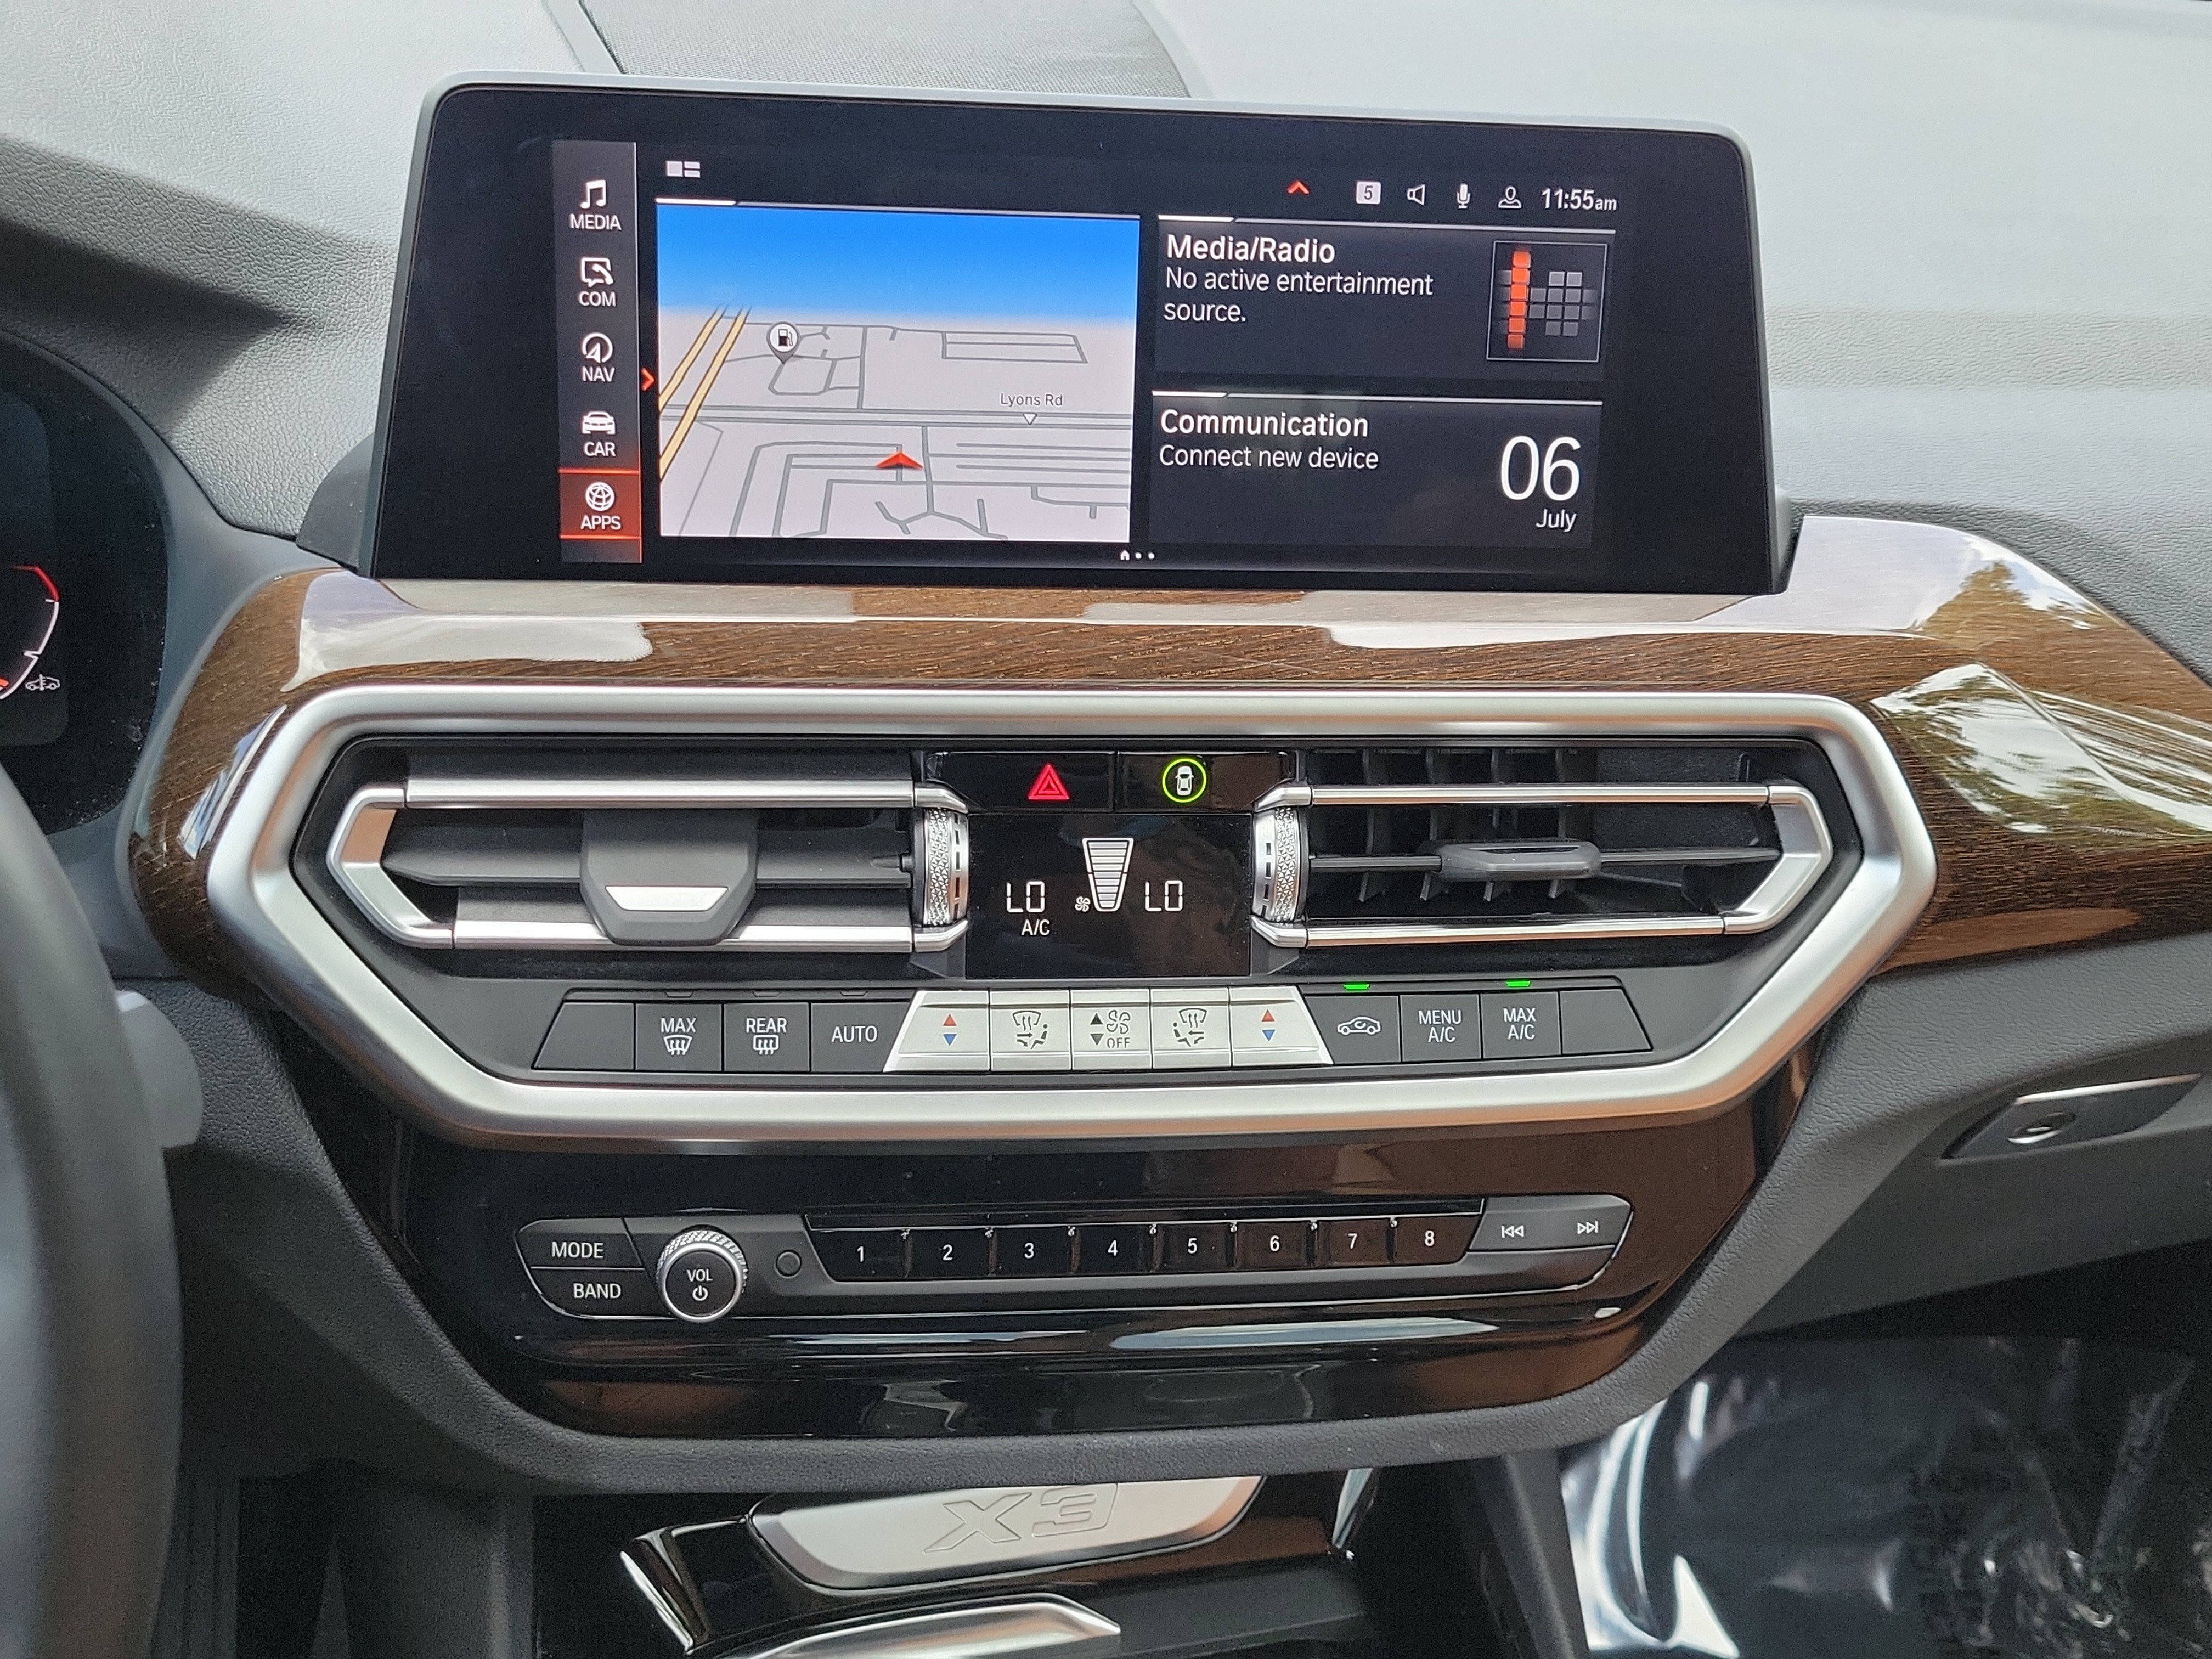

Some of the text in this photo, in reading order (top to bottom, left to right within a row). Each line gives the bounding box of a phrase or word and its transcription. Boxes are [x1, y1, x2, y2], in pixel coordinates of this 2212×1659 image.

[1364, 185, 1373, 200] 5
[1542, 188, 1617, 211] 11:55am
[569, 213, 622, 230] MEDIA
[1167, 234, 1335, 263] Media/Radio
[1166, 266, 1434, 296] No active entertainment
[578, 291, 616, 307] COM
[1164, 303, 1246, 322] source.
[582, 366, 615, 382] NAV
[1001, 393, 1063, 408] Lyons Rd
[1161, 409, 1368, 437] Communication
[584, 441, 616, 456] CAR
[1160, 444, 1379, 469] Connect new device
[1500, 435, 1581, 501] 06
[580, 515, 621, 530] APPS
[1536, 509, 1577, 532] July
[1021, 919, 1050, 935] A/C
[1418, 1009, 1462, 1024] MENU
[1503, 1007, 1537, 1023] MAX
[661, 1018, 696, 1033] MAX
[746, 1018, 787, 1033] REAR
[1508, 1024, 1535, 1040] A/C
[831, 1025, 877, 1043] AUTO
[1428, 1026, 1455, 1042] A/C
[1107, 1037, 1131, 1048] OFF
[1188, 1238, 1197, 1254] 5
[1269, 1235, 1280, 1251] 6
[1348, 1233, 1358, 1249] 7
[1424, 1230, 1435, 1246] 8
[552, 1241, 604, 1259] MODE
[857, 1246, 864, 1262] 1
[943, 1244, 953, 1261] 2
[1024, 1242, 1034, 1259] 3
[1108, 1240, 1118, 1256] 4
[686, 1268, 714, 1282] VOL
[573, 1283, 621, 1299] BAND
[923, 1483, 1118, 1554] X3
